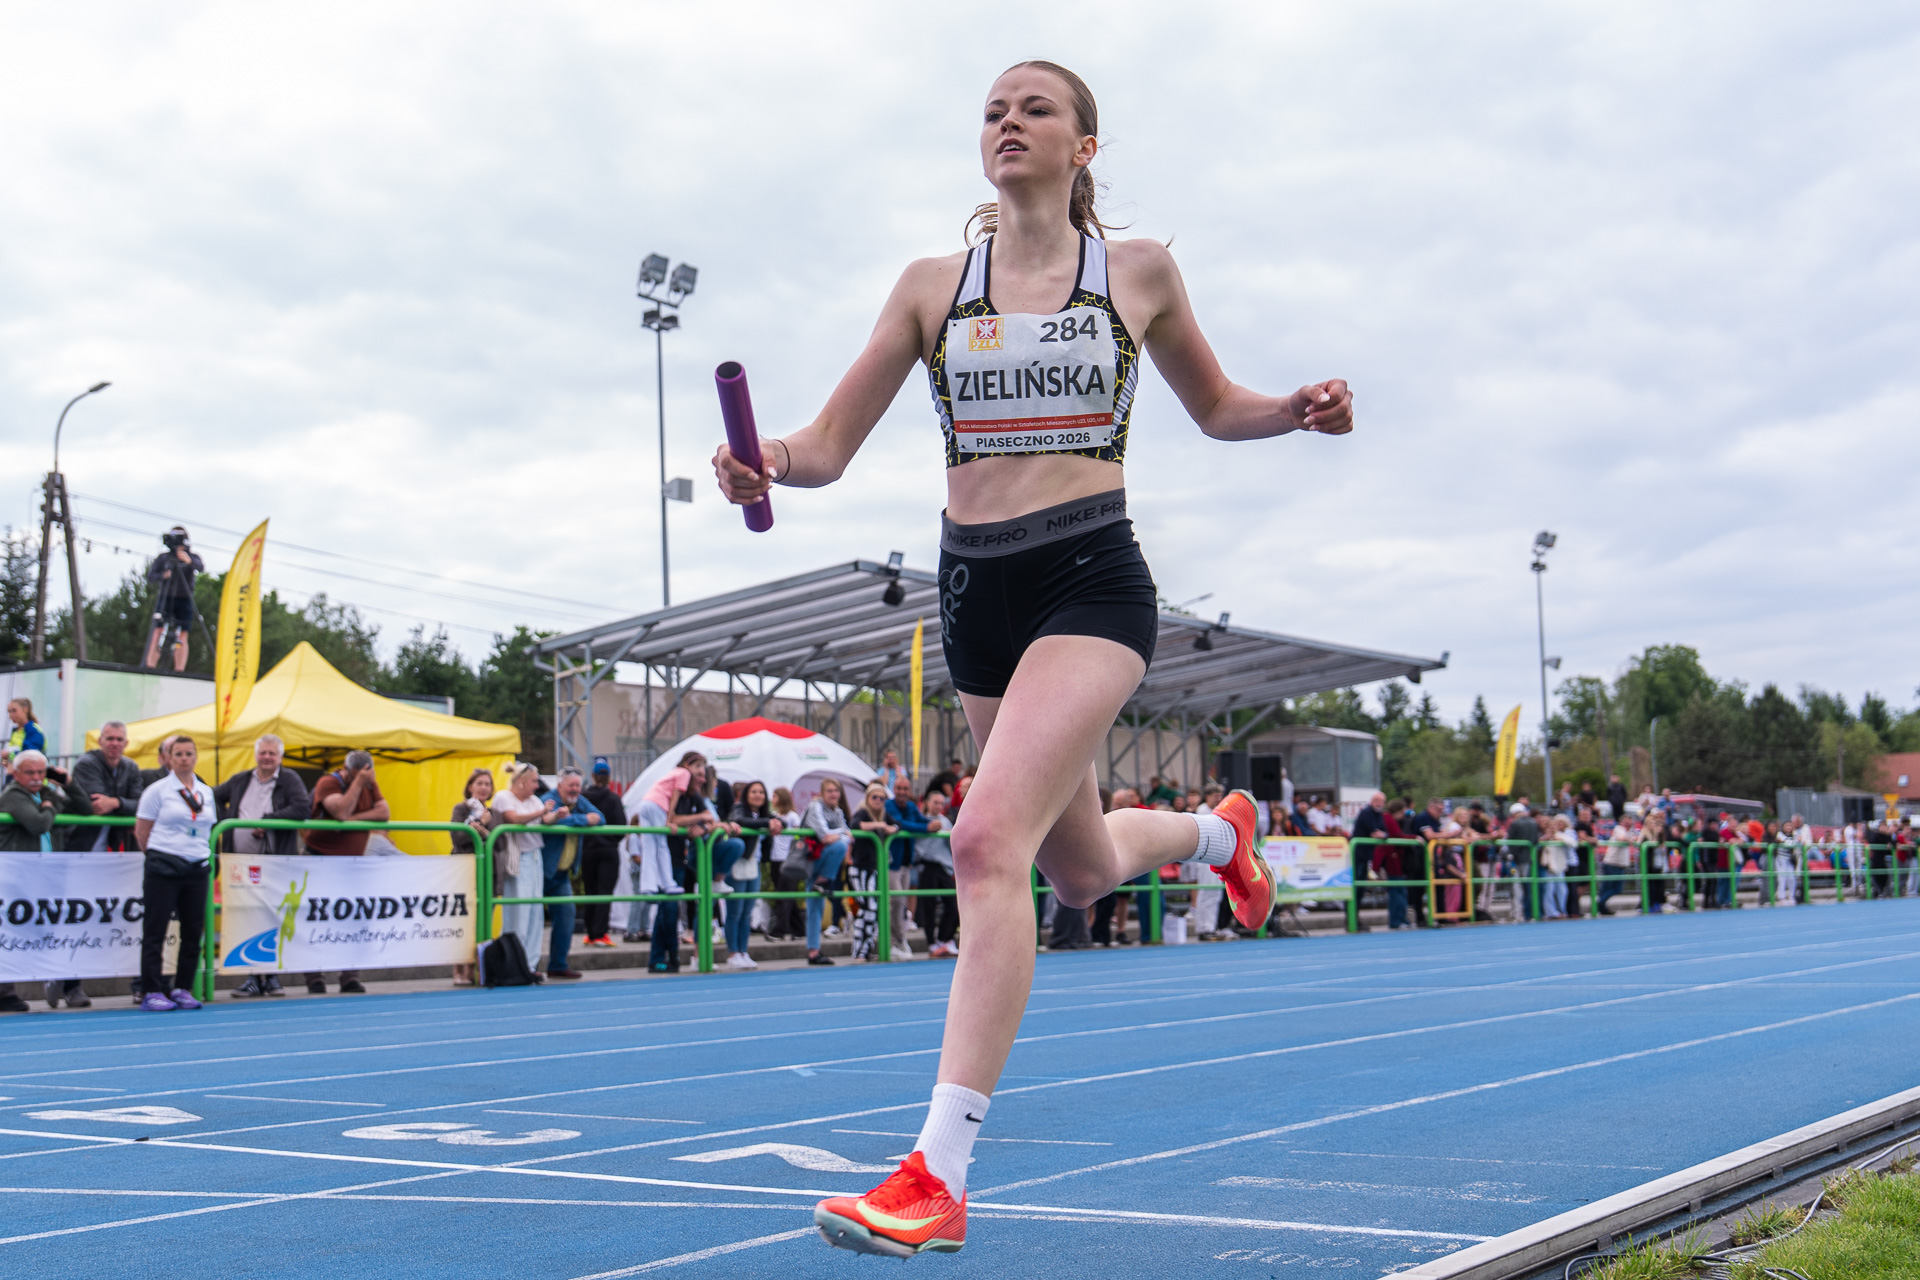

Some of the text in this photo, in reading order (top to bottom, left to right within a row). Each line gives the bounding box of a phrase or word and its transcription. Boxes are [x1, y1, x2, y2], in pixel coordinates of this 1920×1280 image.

[1040, 314, 1098, 342] 284
[970, 339, 1001, 349] PZLA
[955, 360, 1106, 401] ZIELIŃSKA
[976, 432, 1091, 448] PIASECZNO 2026
[1046, 506, 1096, 532] NIKE
[947, 527, 1028, 547] NIKE PRO
[0, 896, 145, 926] ONDYC
[306, 893, 469, 921] KONDYCJA
[341, 1121, 583, 1146] 3
